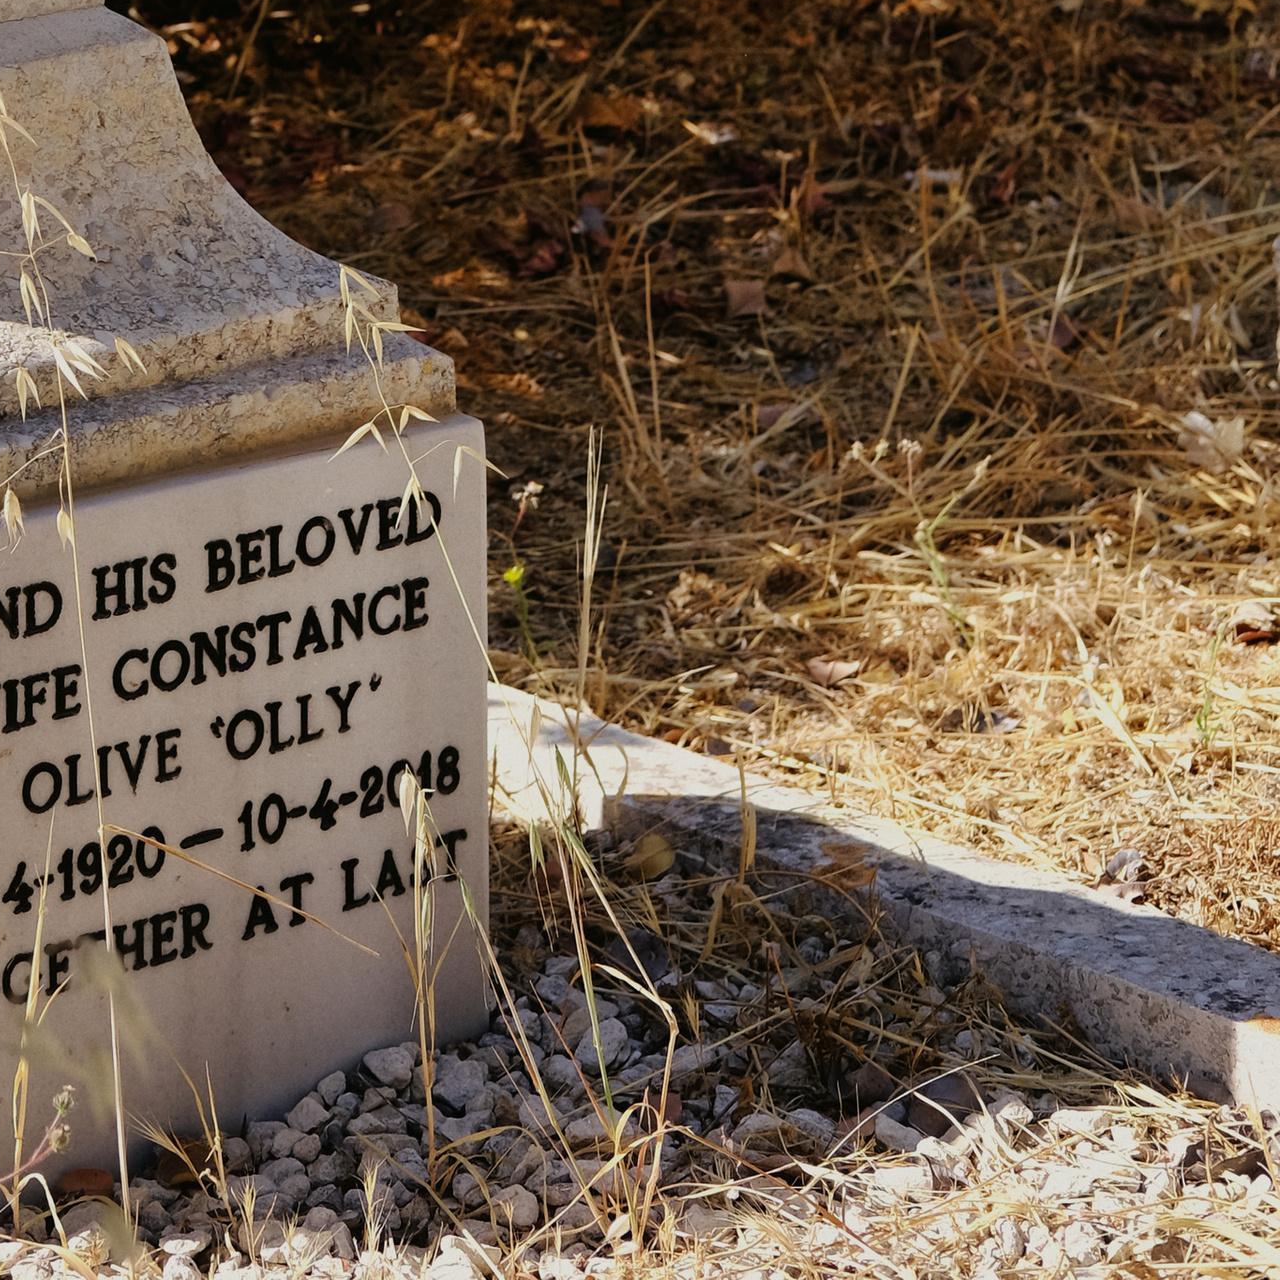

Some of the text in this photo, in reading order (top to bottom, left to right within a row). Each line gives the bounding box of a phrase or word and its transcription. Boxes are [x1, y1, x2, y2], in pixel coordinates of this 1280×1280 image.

[91, 552, 177, 622] HIS
[204, 490, 443, 594] BELOVED
[112, 576, 431, 702] CONSTANCE
[21, 727, 182, 815] OLIVE
[237, 744, 461, 853] 10-4-2018
[241, 872, 315, 941] AT
